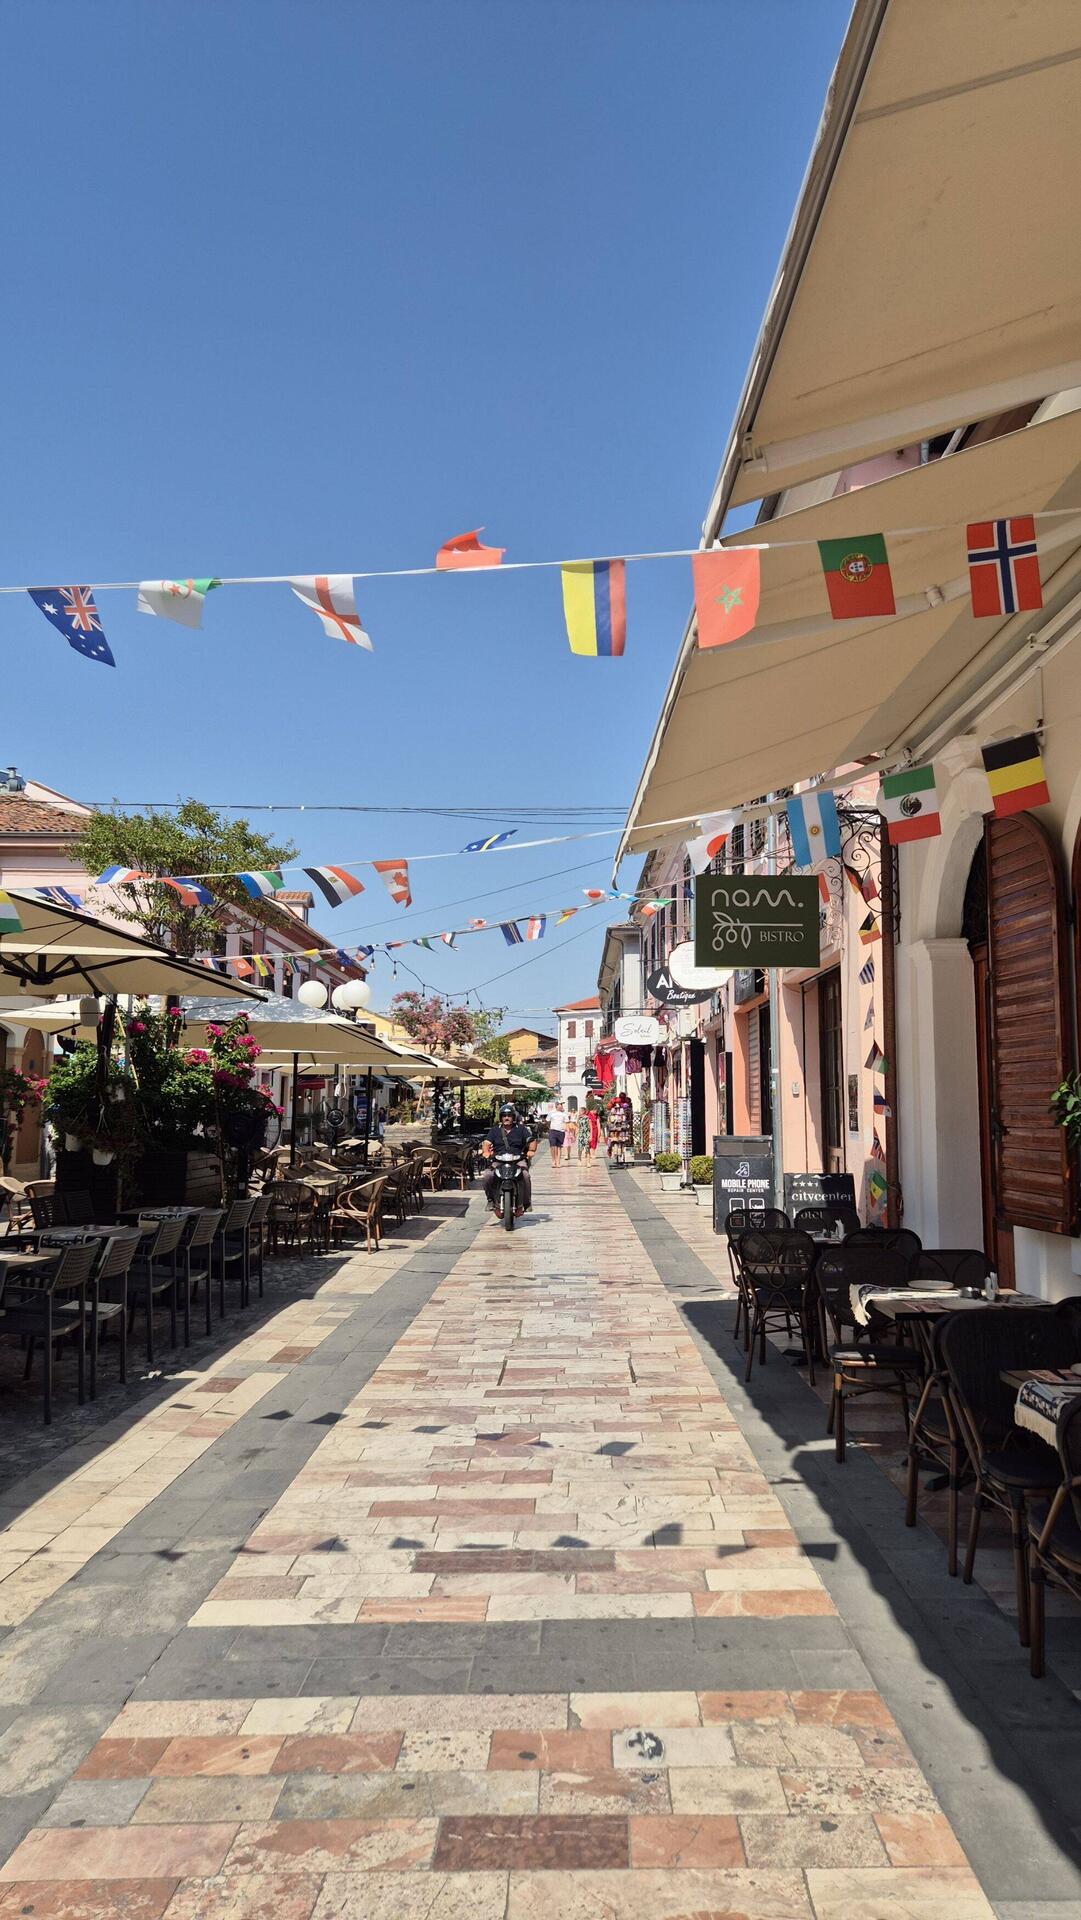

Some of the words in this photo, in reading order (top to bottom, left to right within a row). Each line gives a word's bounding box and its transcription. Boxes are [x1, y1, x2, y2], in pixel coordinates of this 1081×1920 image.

[760, 931, 805, 943] BISTRO
[666, 989, 696, 1003] Boutique
[721, 1179, 747, 1188] MOBILE
[747, 1179, 770, 1189] PHONE
[791, 1190, 853, 1203] citycenter
